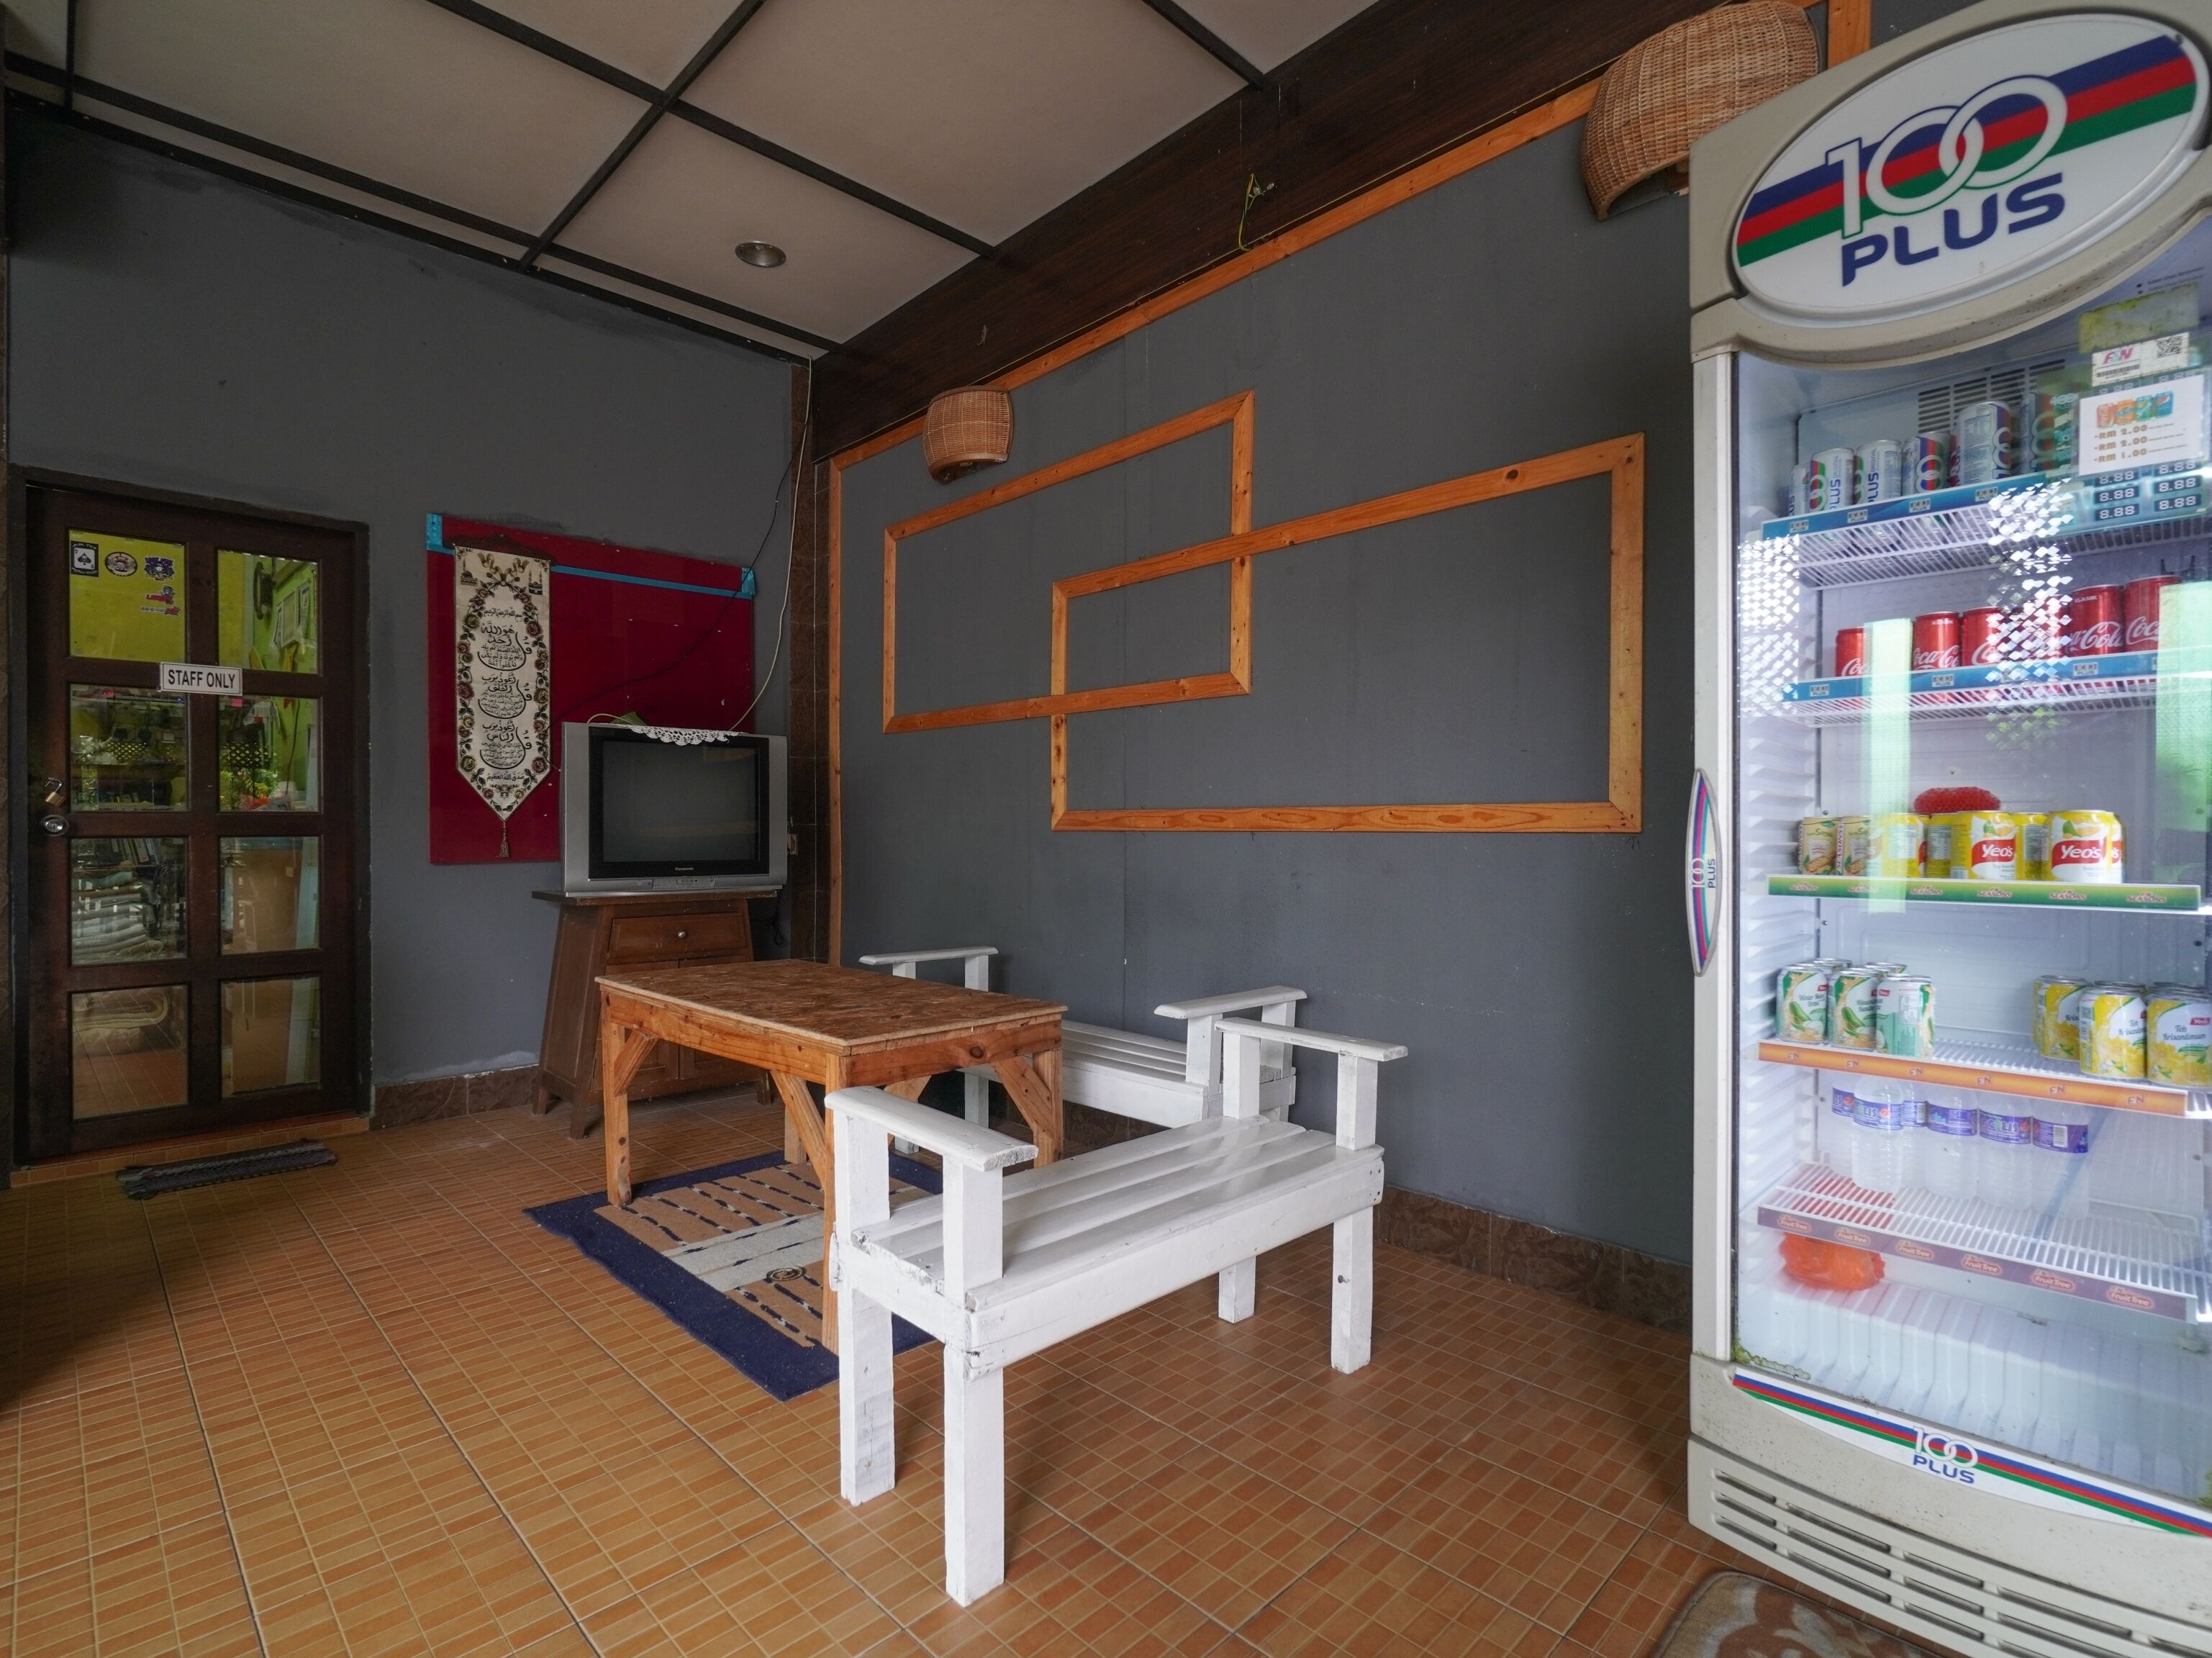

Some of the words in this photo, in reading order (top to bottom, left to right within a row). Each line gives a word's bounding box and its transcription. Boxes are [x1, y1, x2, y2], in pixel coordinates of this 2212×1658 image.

[1825, 74, 2068, 240] 100
[1841, 171, 2065, 287] PLUS
[168, 669, 203, 686] STAFF
[207, 672, 235, 689] ONLY
[1982, 844, 2013, 858] Yeo's
[2061, 845, 2102, 859] Yeo's
[2127, 894, 2166, 903] SEASONS
[1913, 1426, 1978, 1468] 100
[1913, 1454, 1975, 1484] PLUS
